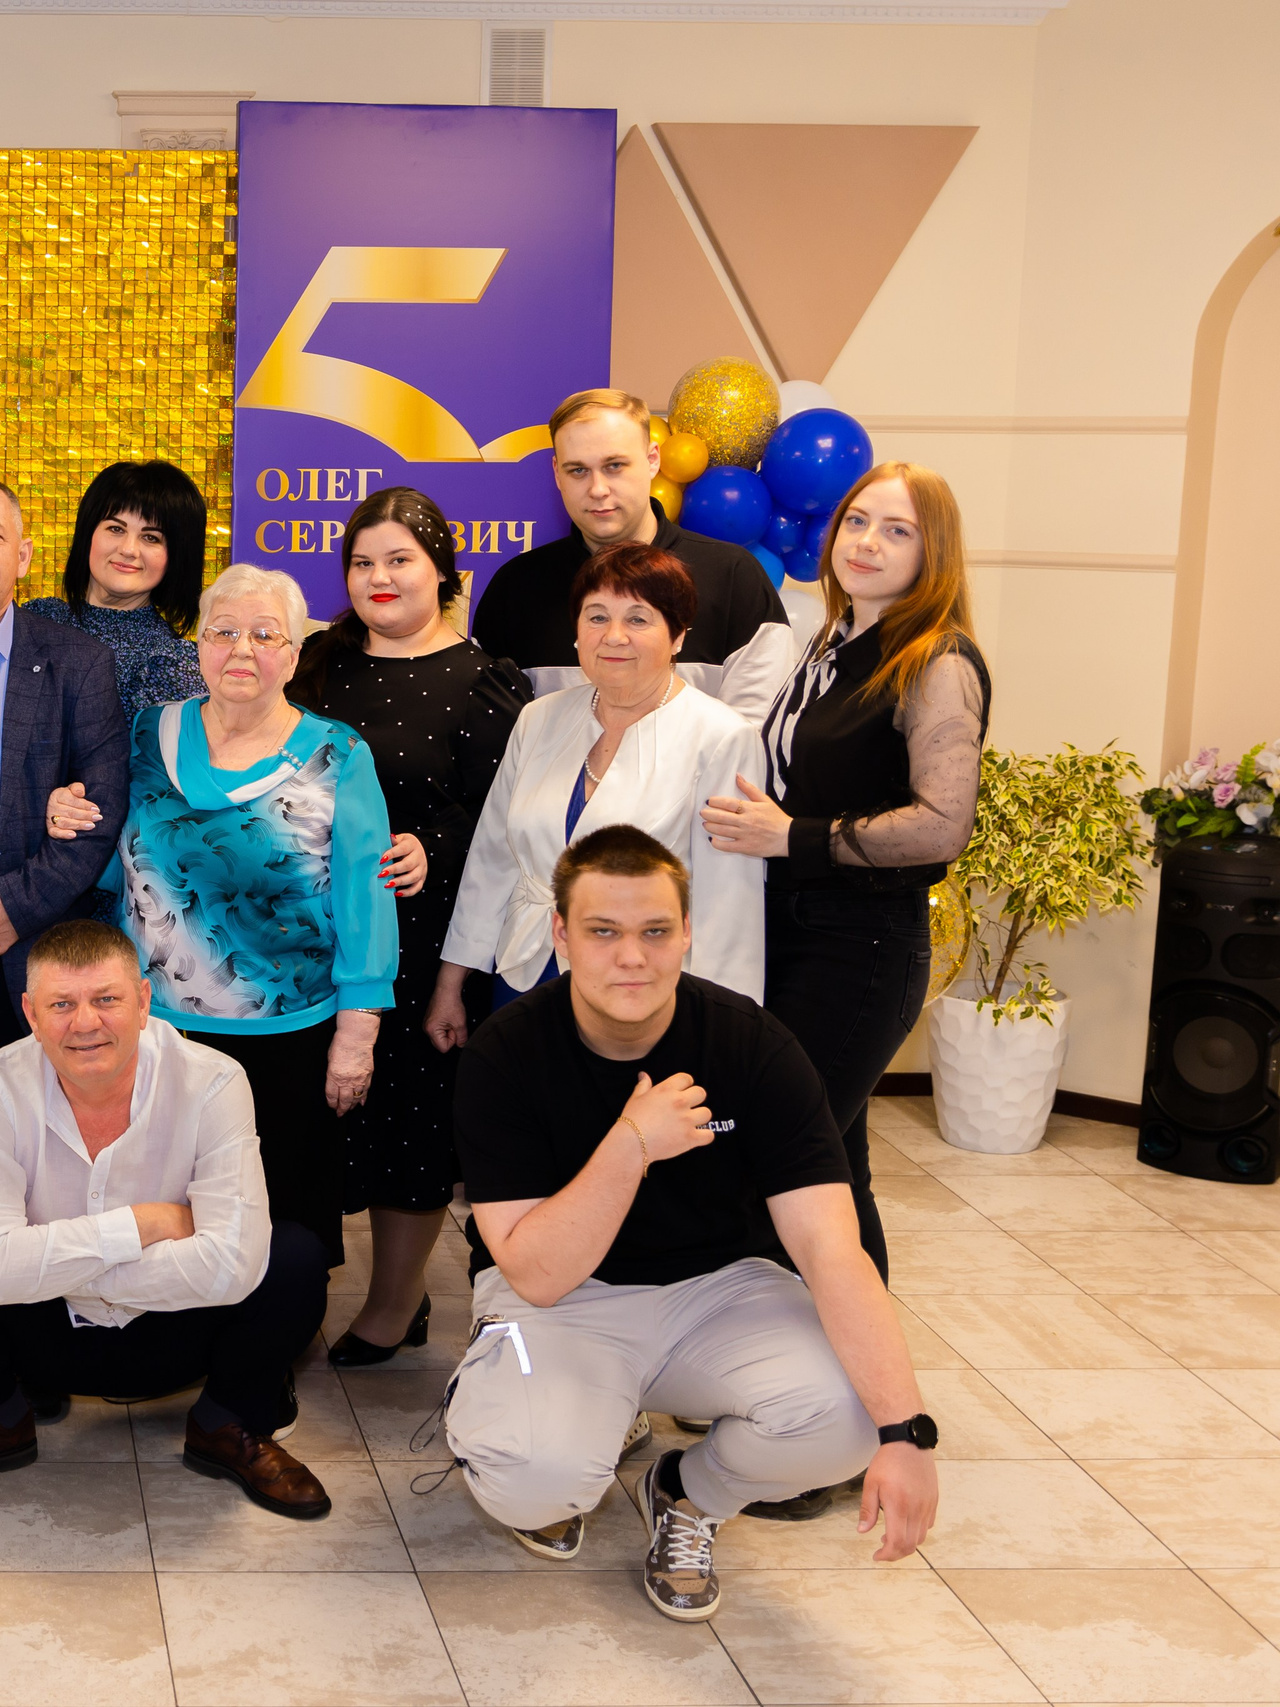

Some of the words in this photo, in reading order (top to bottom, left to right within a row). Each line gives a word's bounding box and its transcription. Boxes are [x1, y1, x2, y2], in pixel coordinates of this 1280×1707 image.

[256, 468, 383, 501] ОЛЕГ
[254, 519, 537, 554] СЕРВИЧ
[708, 1119, 735, 1131] CLUB
